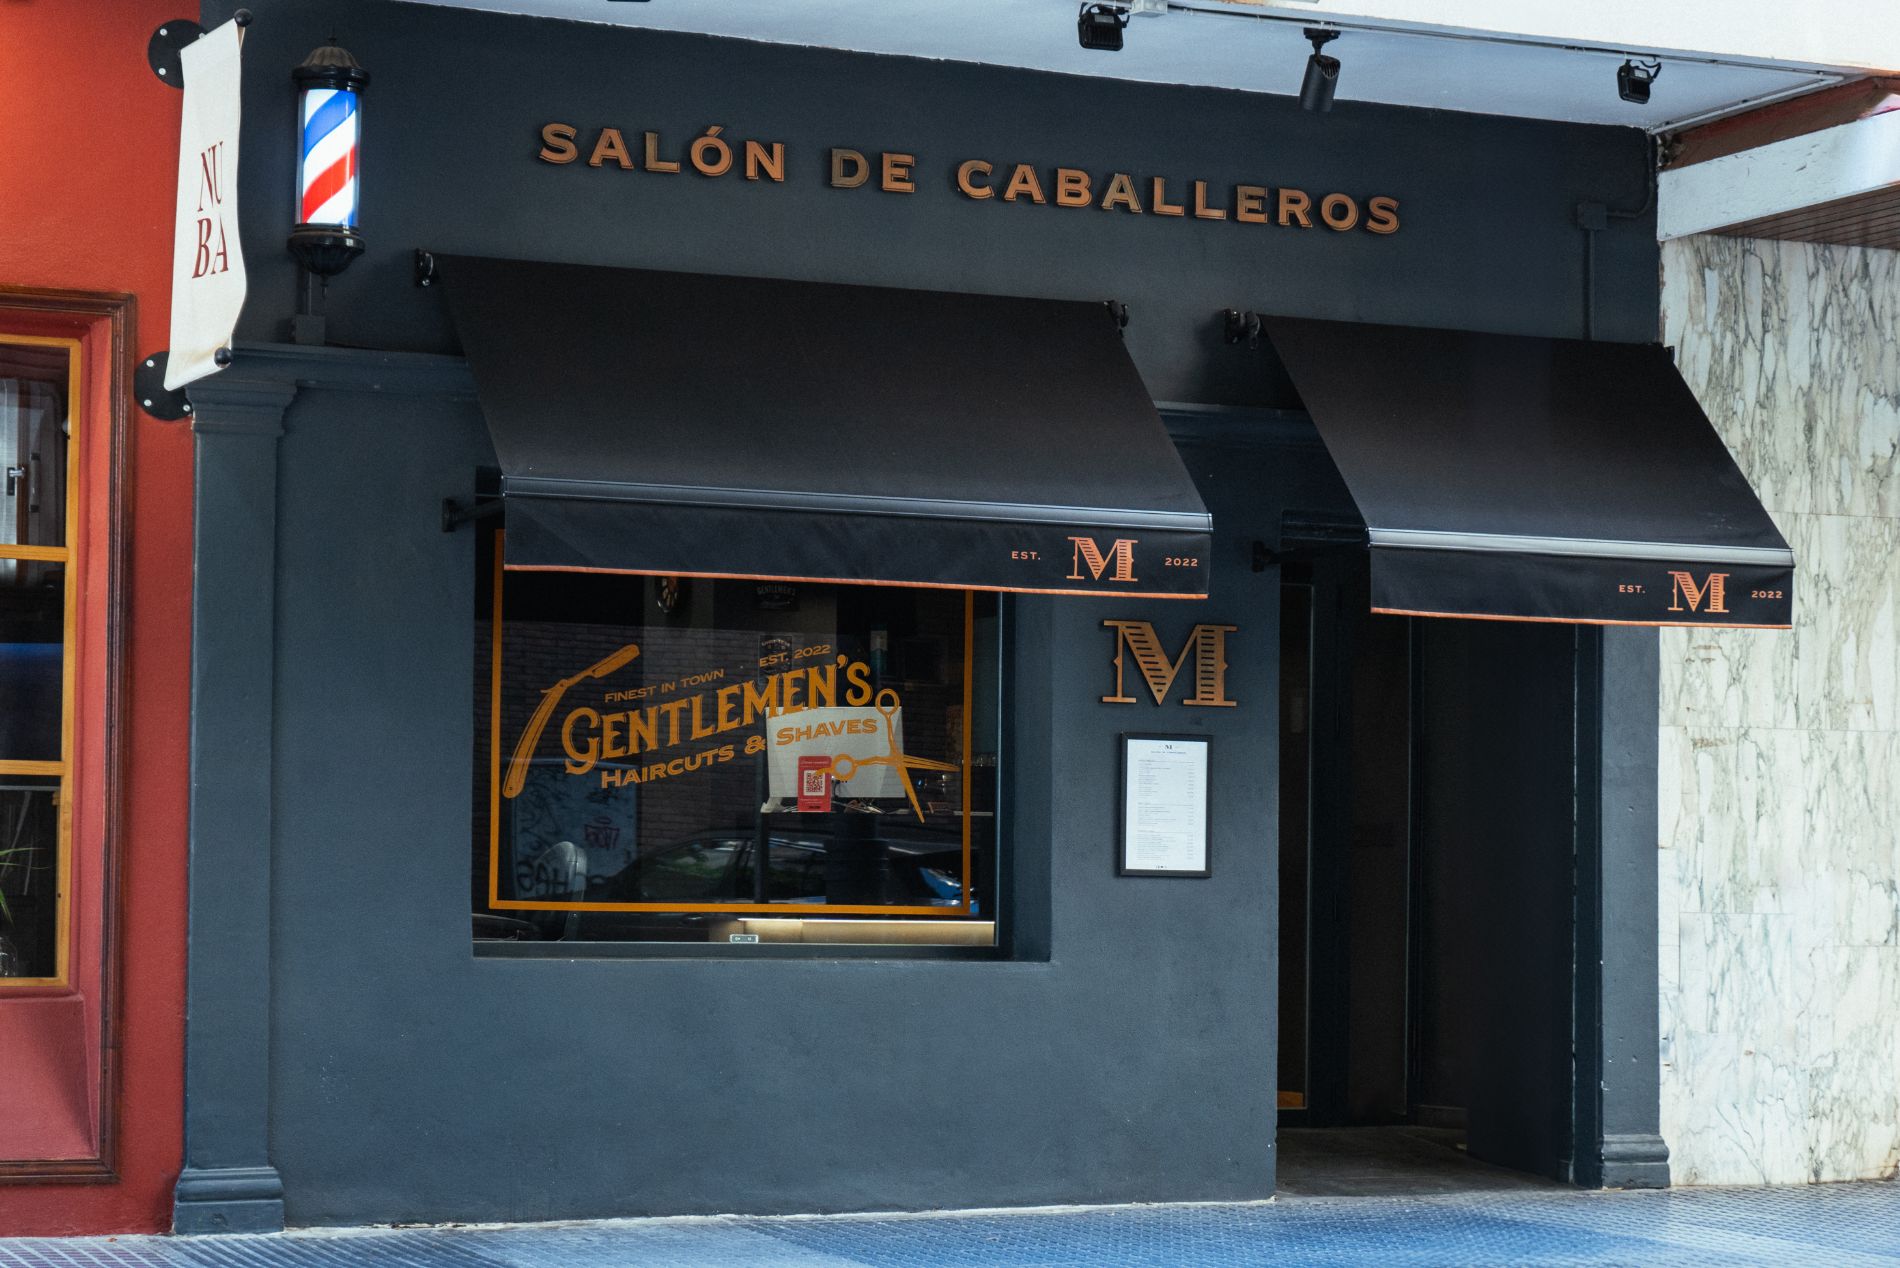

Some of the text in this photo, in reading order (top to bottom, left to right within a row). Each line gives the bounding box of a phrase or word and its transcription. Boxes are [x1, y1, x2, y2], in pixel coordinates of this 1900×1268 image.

[539, 122, 1401, 234] SALÓN DE CABALLEROS
[1010, 536, 1199, 582] EST. M 2022
[1618, 570, 1784, 614] EST. M 2022
[604, 668, 725, 703] FINEST IN TOWN
[759, 653, 791, 668] EST.
[794, 644, 831, 660] 2022
[1101, 619, 1239, 708] M
[561, 653, 874, 776] GENTLEMEN'S
[601, 717, 878, 789] HAIRCUTS & SHAVES
